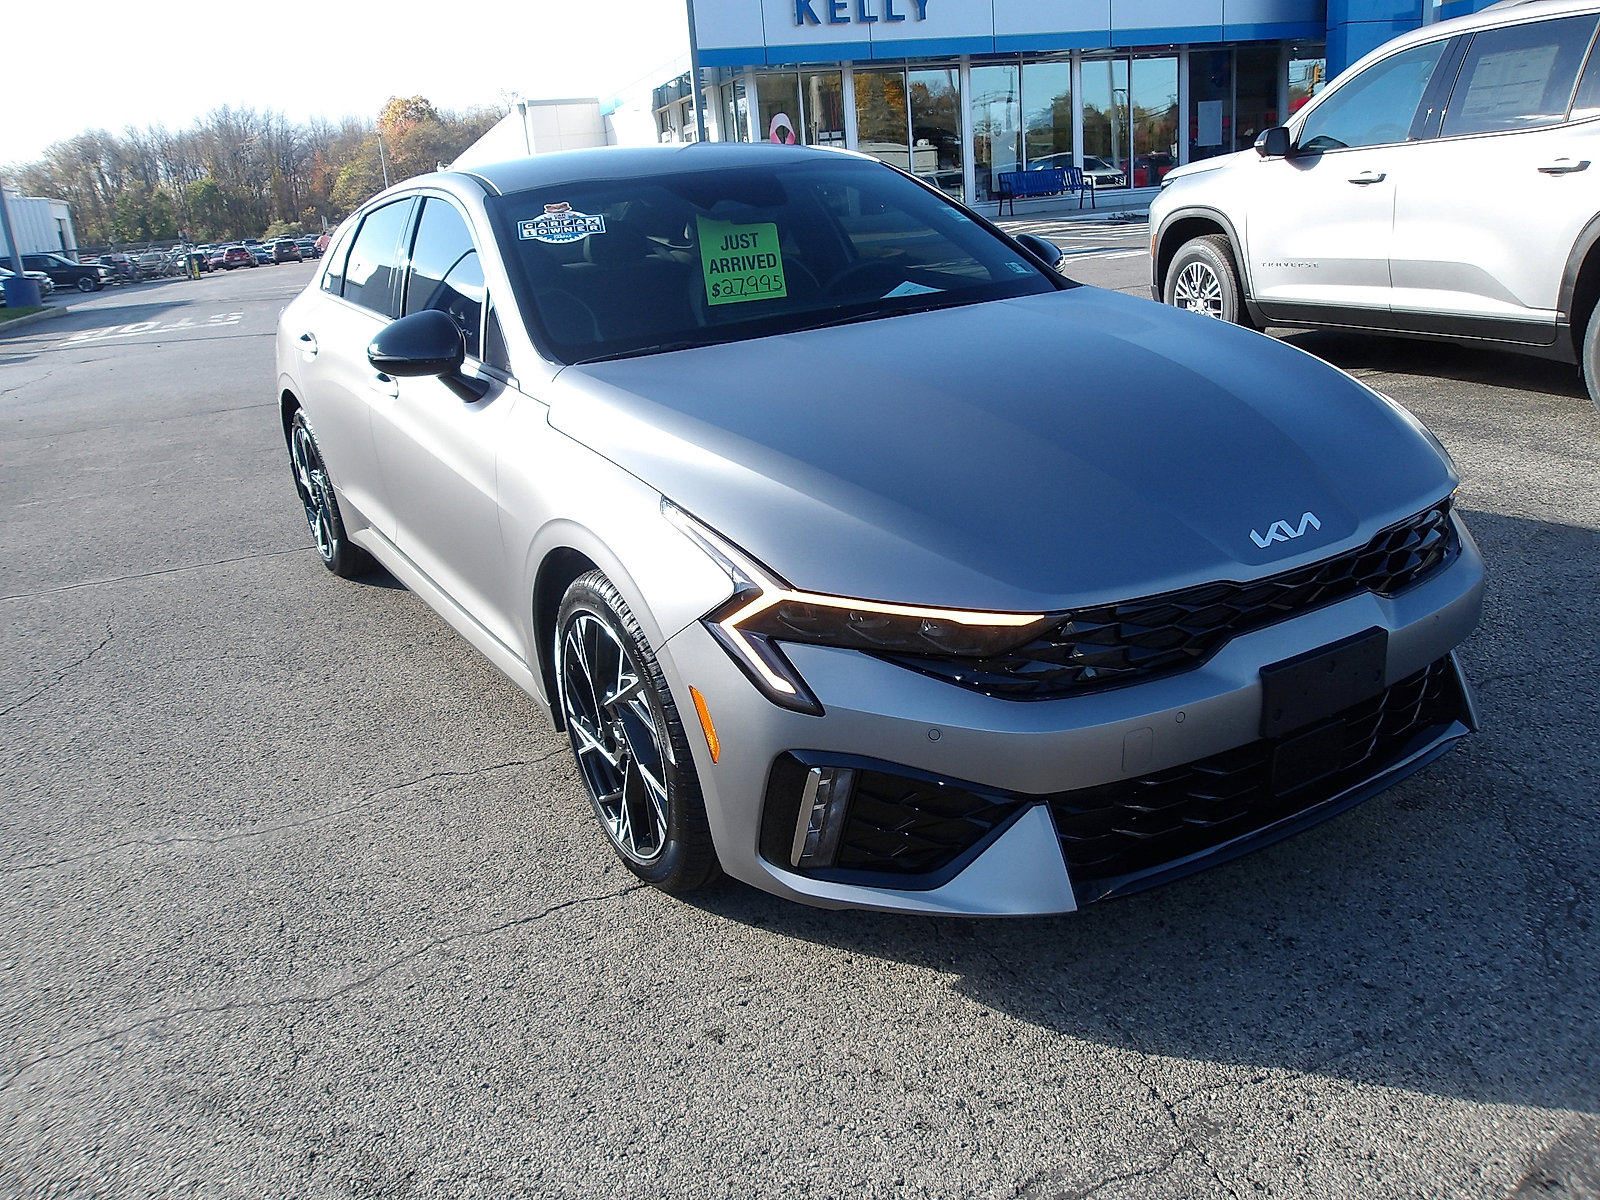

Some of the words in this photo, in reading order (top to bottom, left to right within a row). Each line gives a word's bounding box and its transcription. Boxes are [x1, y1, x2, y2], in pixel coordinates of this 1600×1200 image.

[525, 218, 598, 229] CARFAX
[538, 224, 599, 235] OWNER
[721, 232, 759, 251] JUST
[709, 253, 777, 274] ARRIVED
